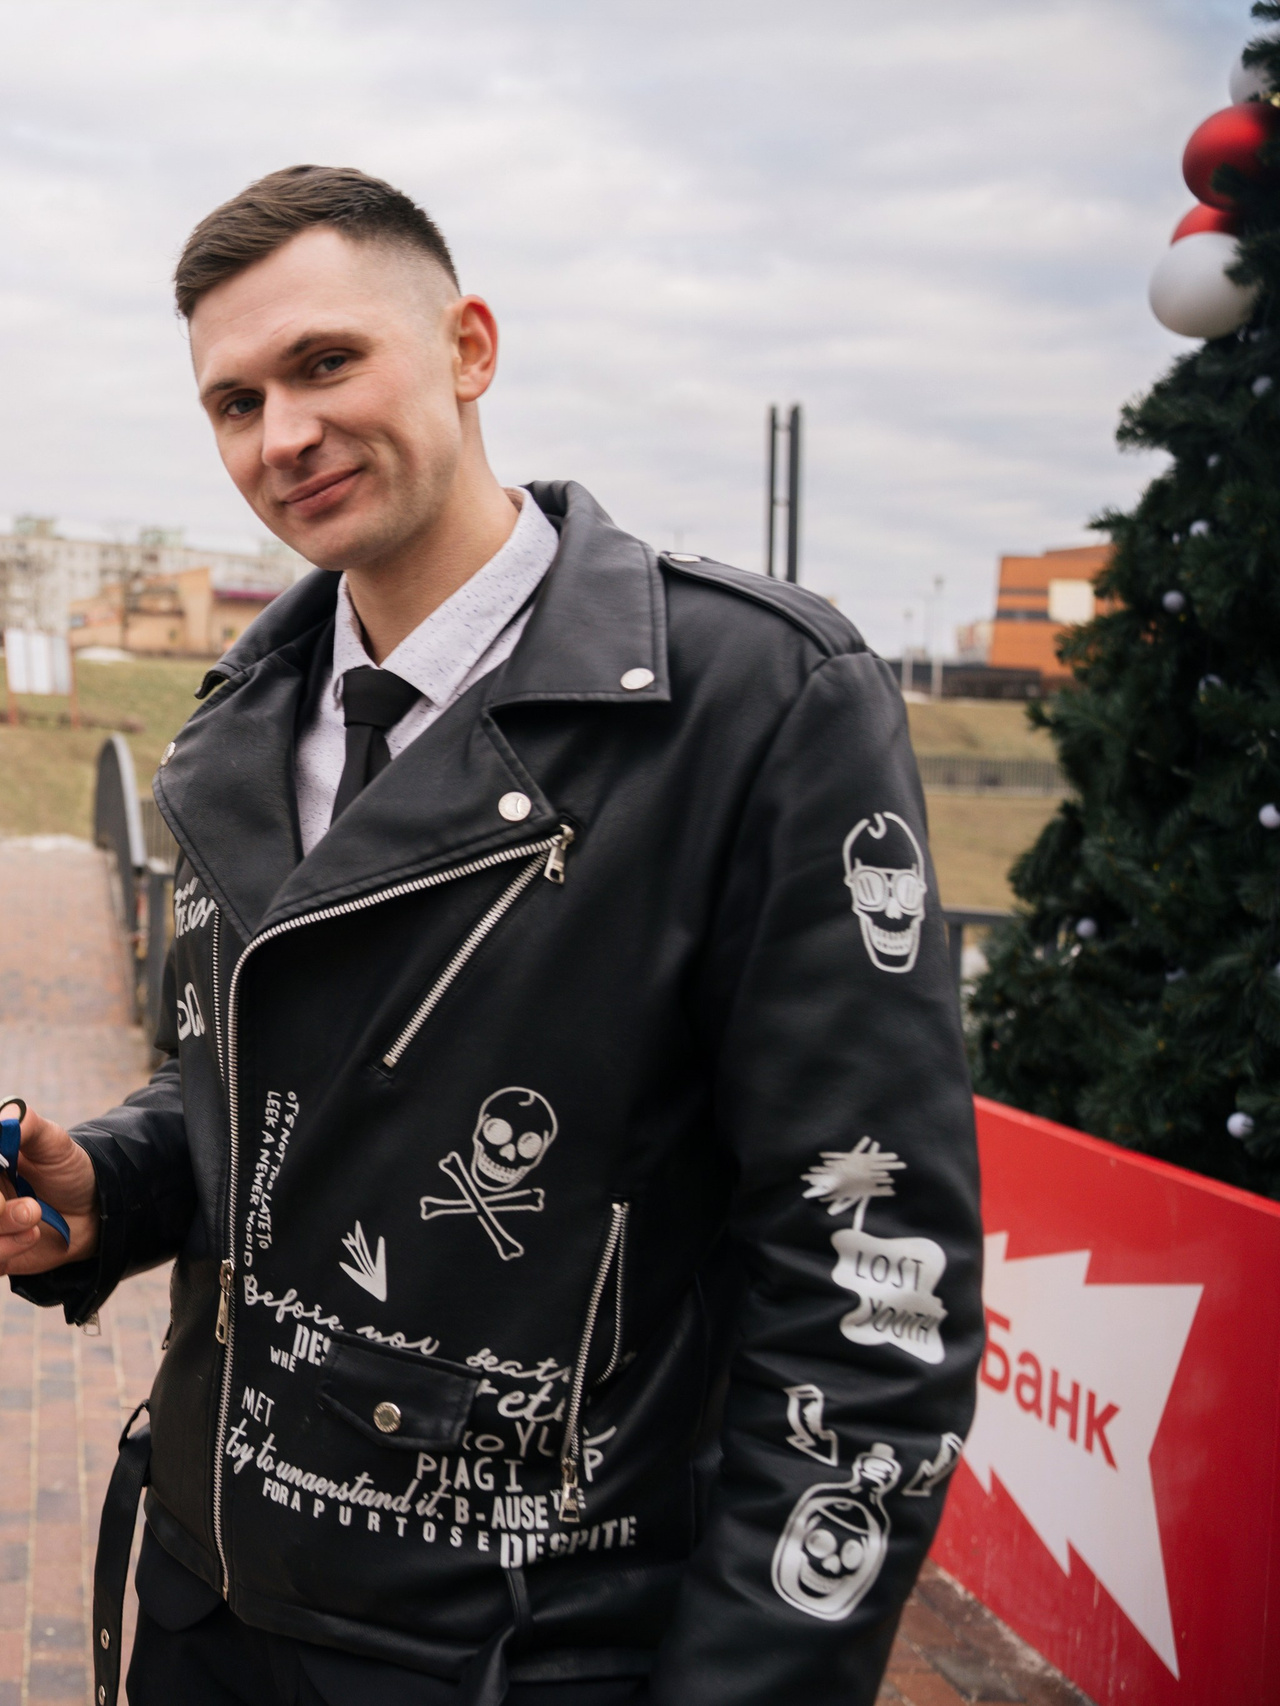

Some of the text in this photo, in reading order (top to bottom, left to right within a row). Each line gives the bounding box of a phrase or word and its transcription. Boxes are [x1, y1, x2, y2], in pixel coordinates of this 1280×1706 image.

[261, 1130, 276, 1144] A
[275, 1127, 291, 1164] NOT
[249, 1148, 271, 1206] NEWER
[266, 1164, 281, 1190] TOO
[257, 1192, 273, 1233] LATE
[255, 1232, 273, 1250] TO
[855, 1250, 924, 1292] LOST
[855, 1296, 939, 1345] YOUTH
[241, 1385, 276, 1427] MET
[980, 1306, 1121, 1472] Банк
[225, 1417, 256, 1475] try
[256, 1432, 278, 1473] to
[262, 1476, 289, 1506] FOR
[291, 1490, 302, 1512] A
[499, 1515, 638, 1569] DESPITE
